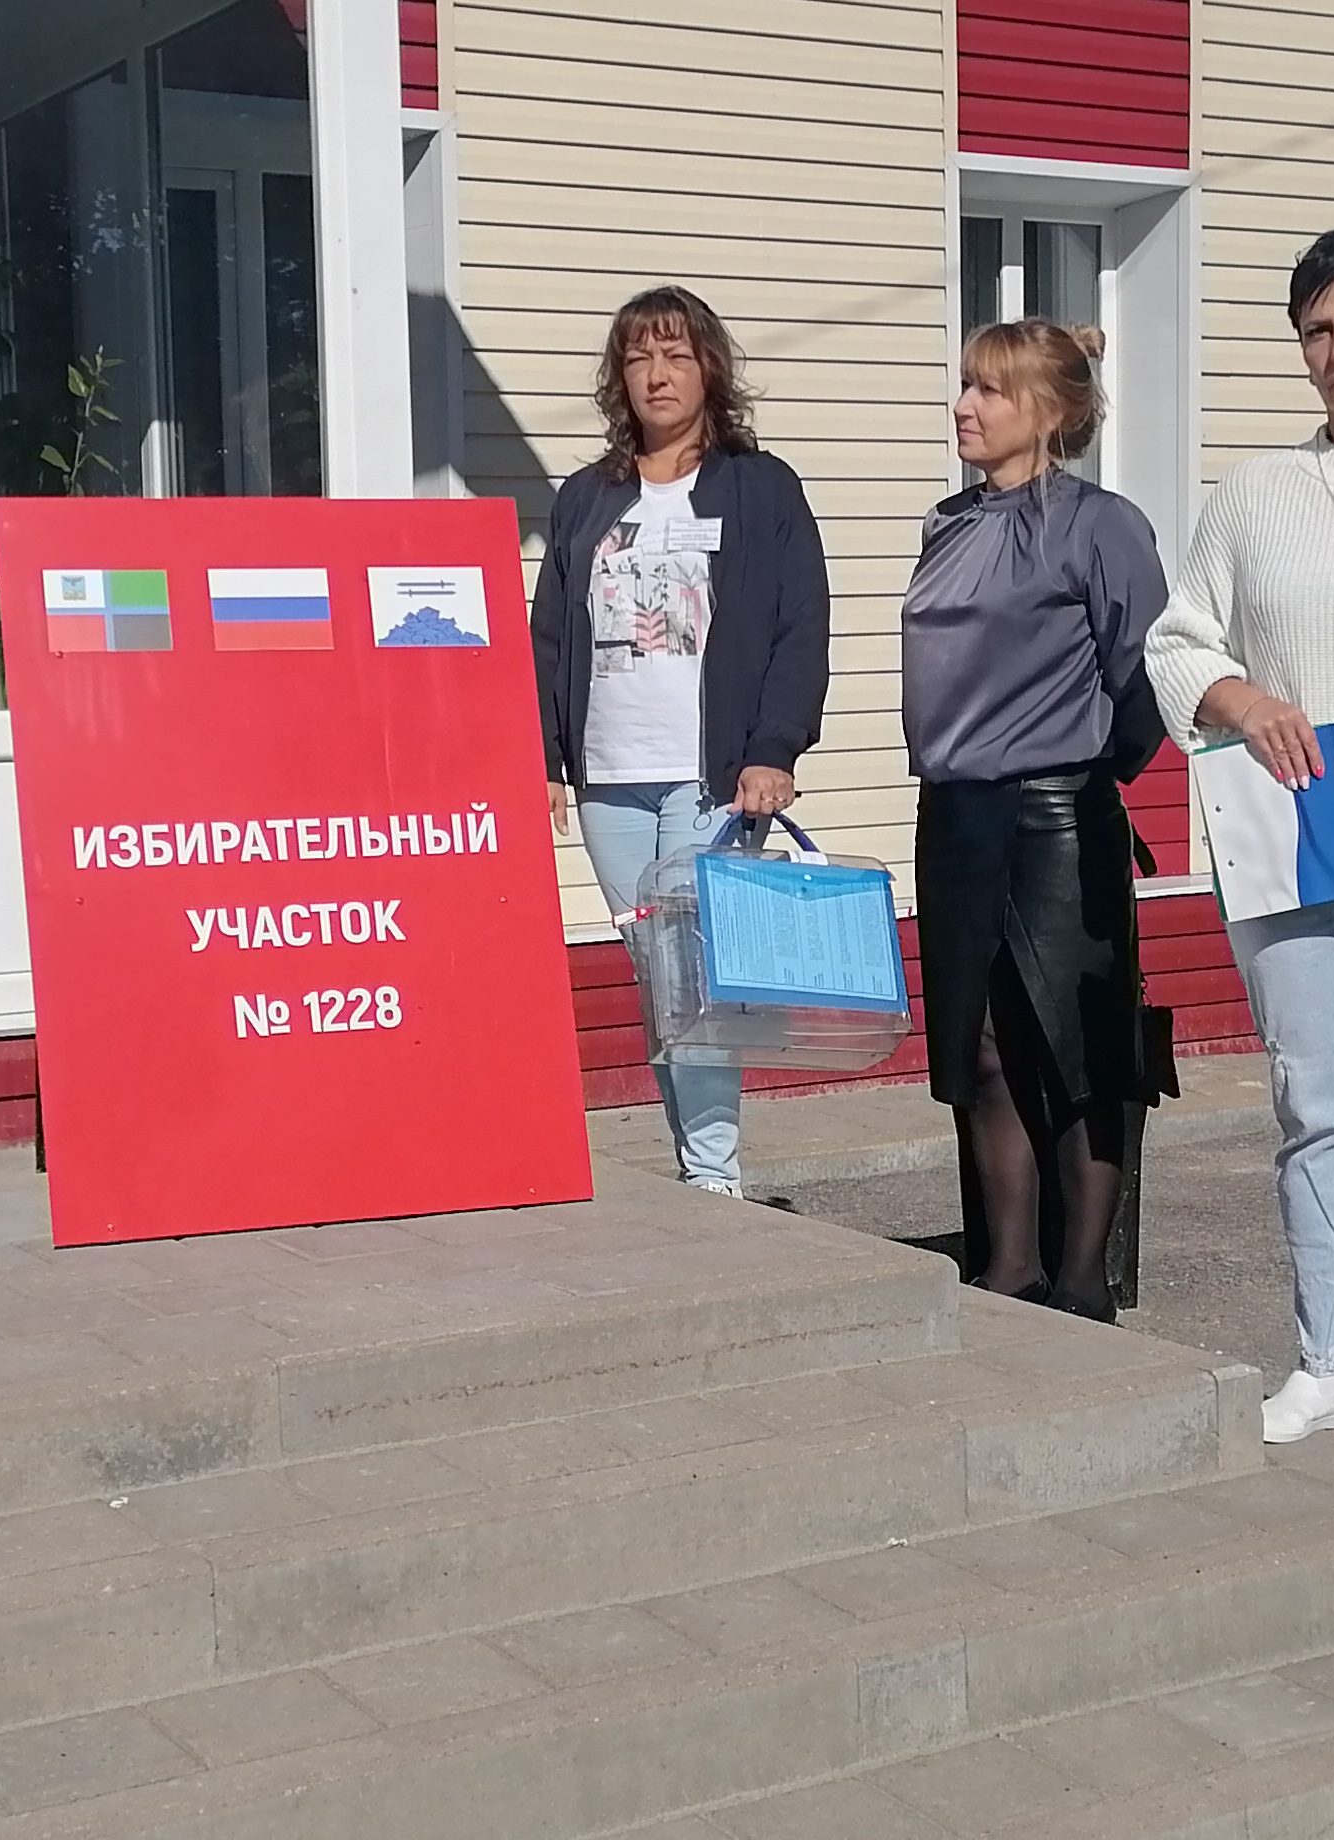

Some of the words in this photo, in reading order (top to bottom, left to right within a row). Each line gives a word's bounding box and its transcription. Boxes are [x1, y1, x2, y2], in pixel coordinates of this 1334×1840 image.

[72, 802, 499, 869] ИЗБИРАТЕЛЬНЫЙ
[185, 899, 407, 953] УЧАСТОК
[232, 993, 291, 1039] №
[302, 985, 403, 1034] 1228
